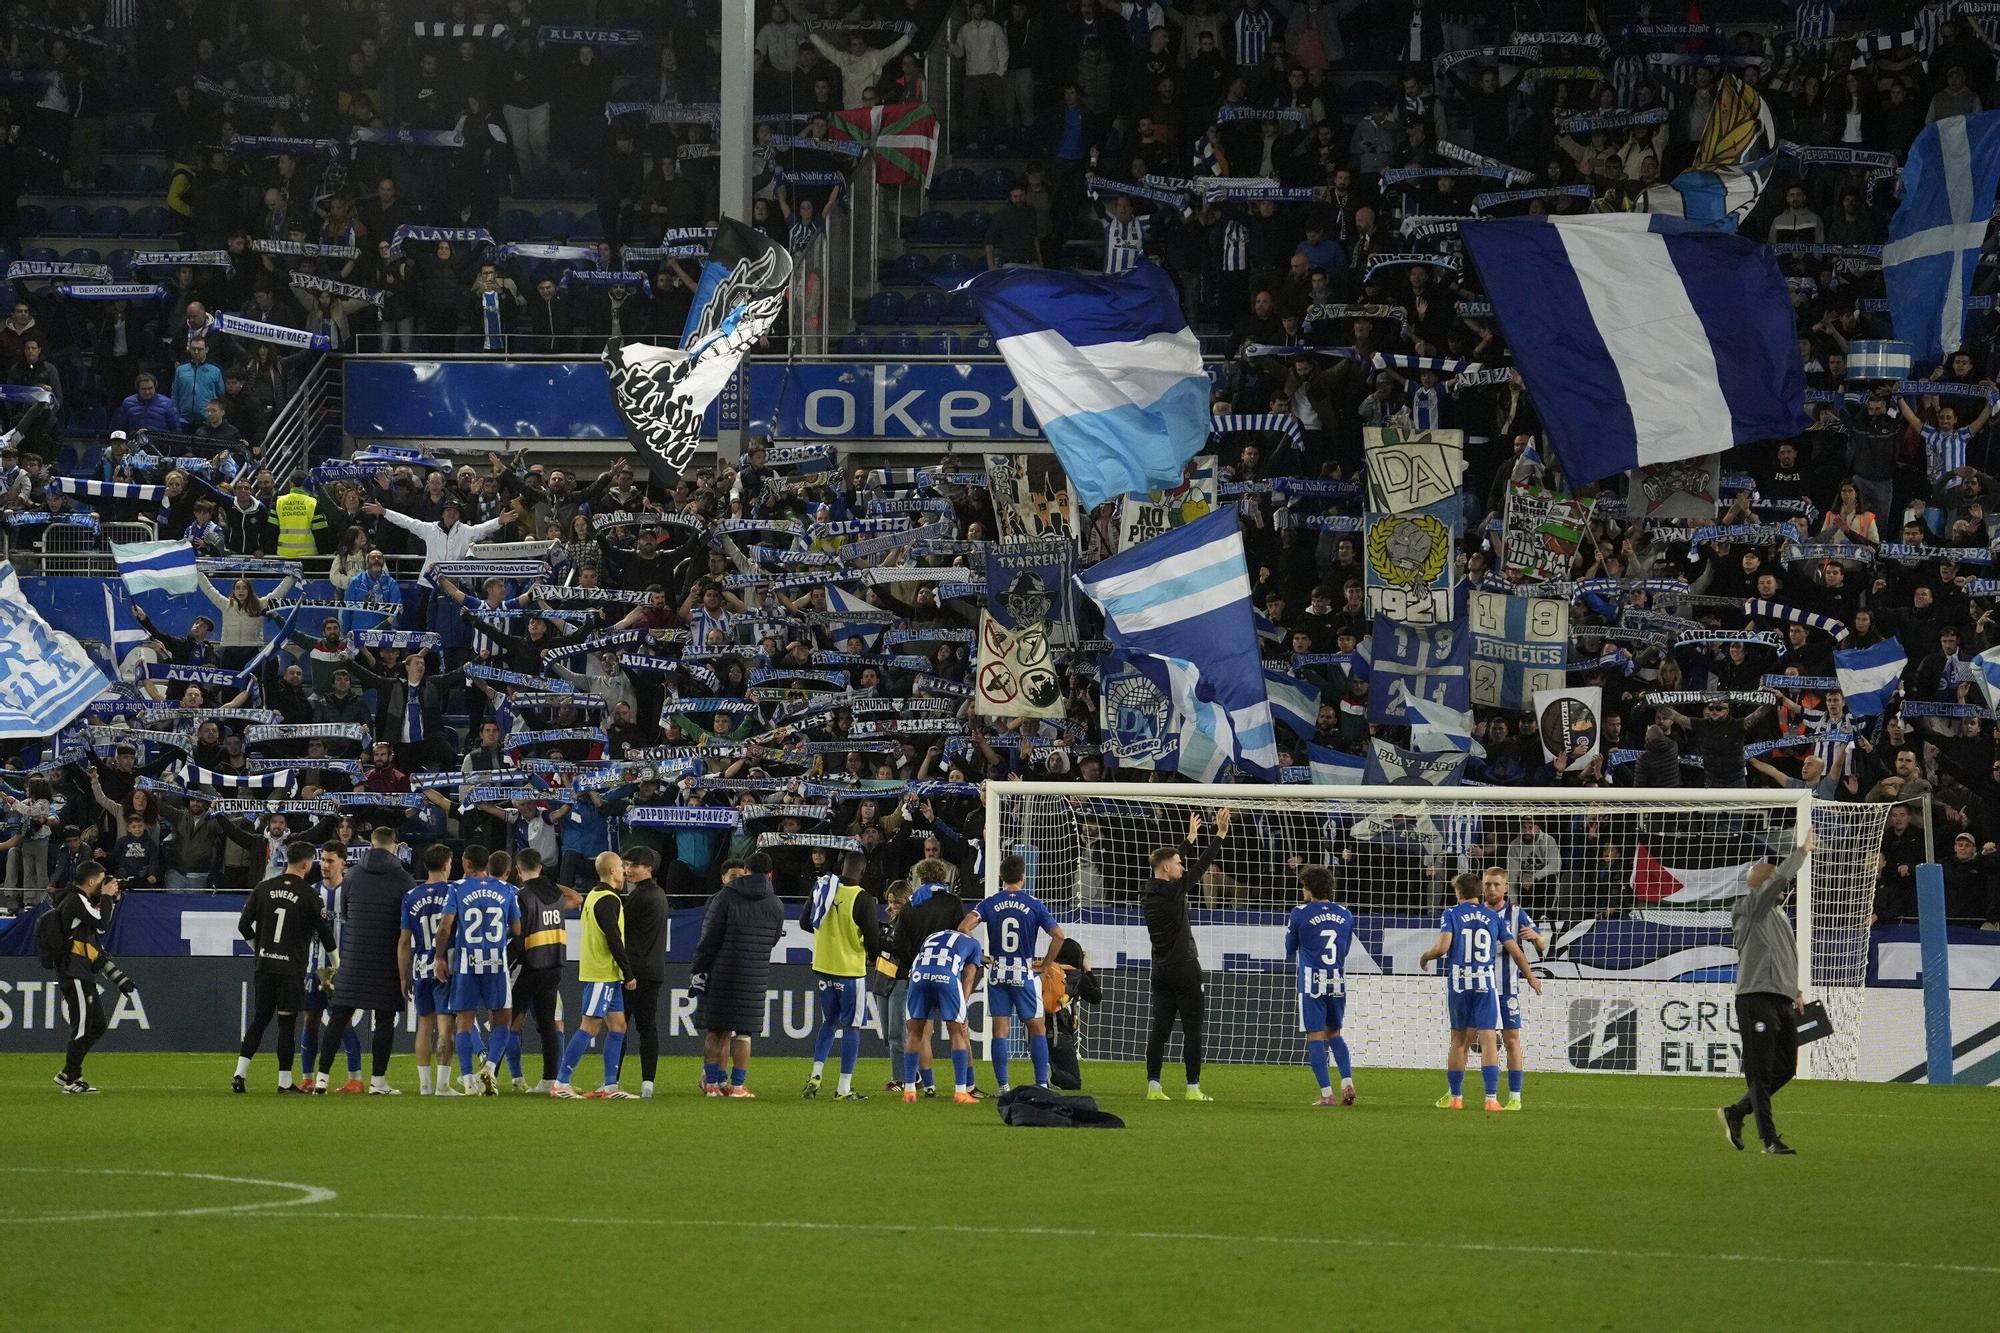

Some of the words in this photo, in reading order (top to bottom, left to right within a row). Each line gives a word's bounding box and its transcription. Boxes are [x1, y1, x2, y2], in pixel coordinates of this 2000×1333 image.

[551, 29, 621, 42] ALAVES
[408, 230, 477, 241] ALAVES
[1285, 480, 1304, 493] Aqui
[1305, 480, 1327, 491] Nadie
[885, 500, 922, 513] ERREKO
[1137, 506, 1164, 527] NO
[991, 544, 1021, 556] ZUEN
[997, 553, 1067, 568] TXARRENA
[1367, 586, 1450, 623] 1921
[1477, 593, 1497, 631] 1
[1474, 635, 1563, 665] Fanatics
[170, 663, 216, 673] DEPORTIVO
[166, 669, 233, 686] ALAVÉS
[1475, 665, 1496, 704] 2
[1378, 748, 1416, 768] PLAY
[1418, 761, 1458, 772] HARD
[640, 808, 690, 821] DEPORTIVO
[695, 808, 729, 823] ALAVÉS
[269, 889, 299, 904] SIVERA
[462, 888, 506, 906] PROTESONI
[410, 896, 433, 917] LUCAS
[993, 900, 1031, 915] GUEVARA
[274, 907, 287, 944] 1
[463, 906, 504, 944] 23
[542, 909, 561, 926] 078
[1310, 915, 1347, 927] YOUSSEF
[1460, 911, 1491, 926] IBAÑEZ
[1001, 916, 1020, 953] 6
[1319, 928, 1338, 966] 3
[1461, 927, 1492, 963] 19
[604, 985, 614, 1002] 18
